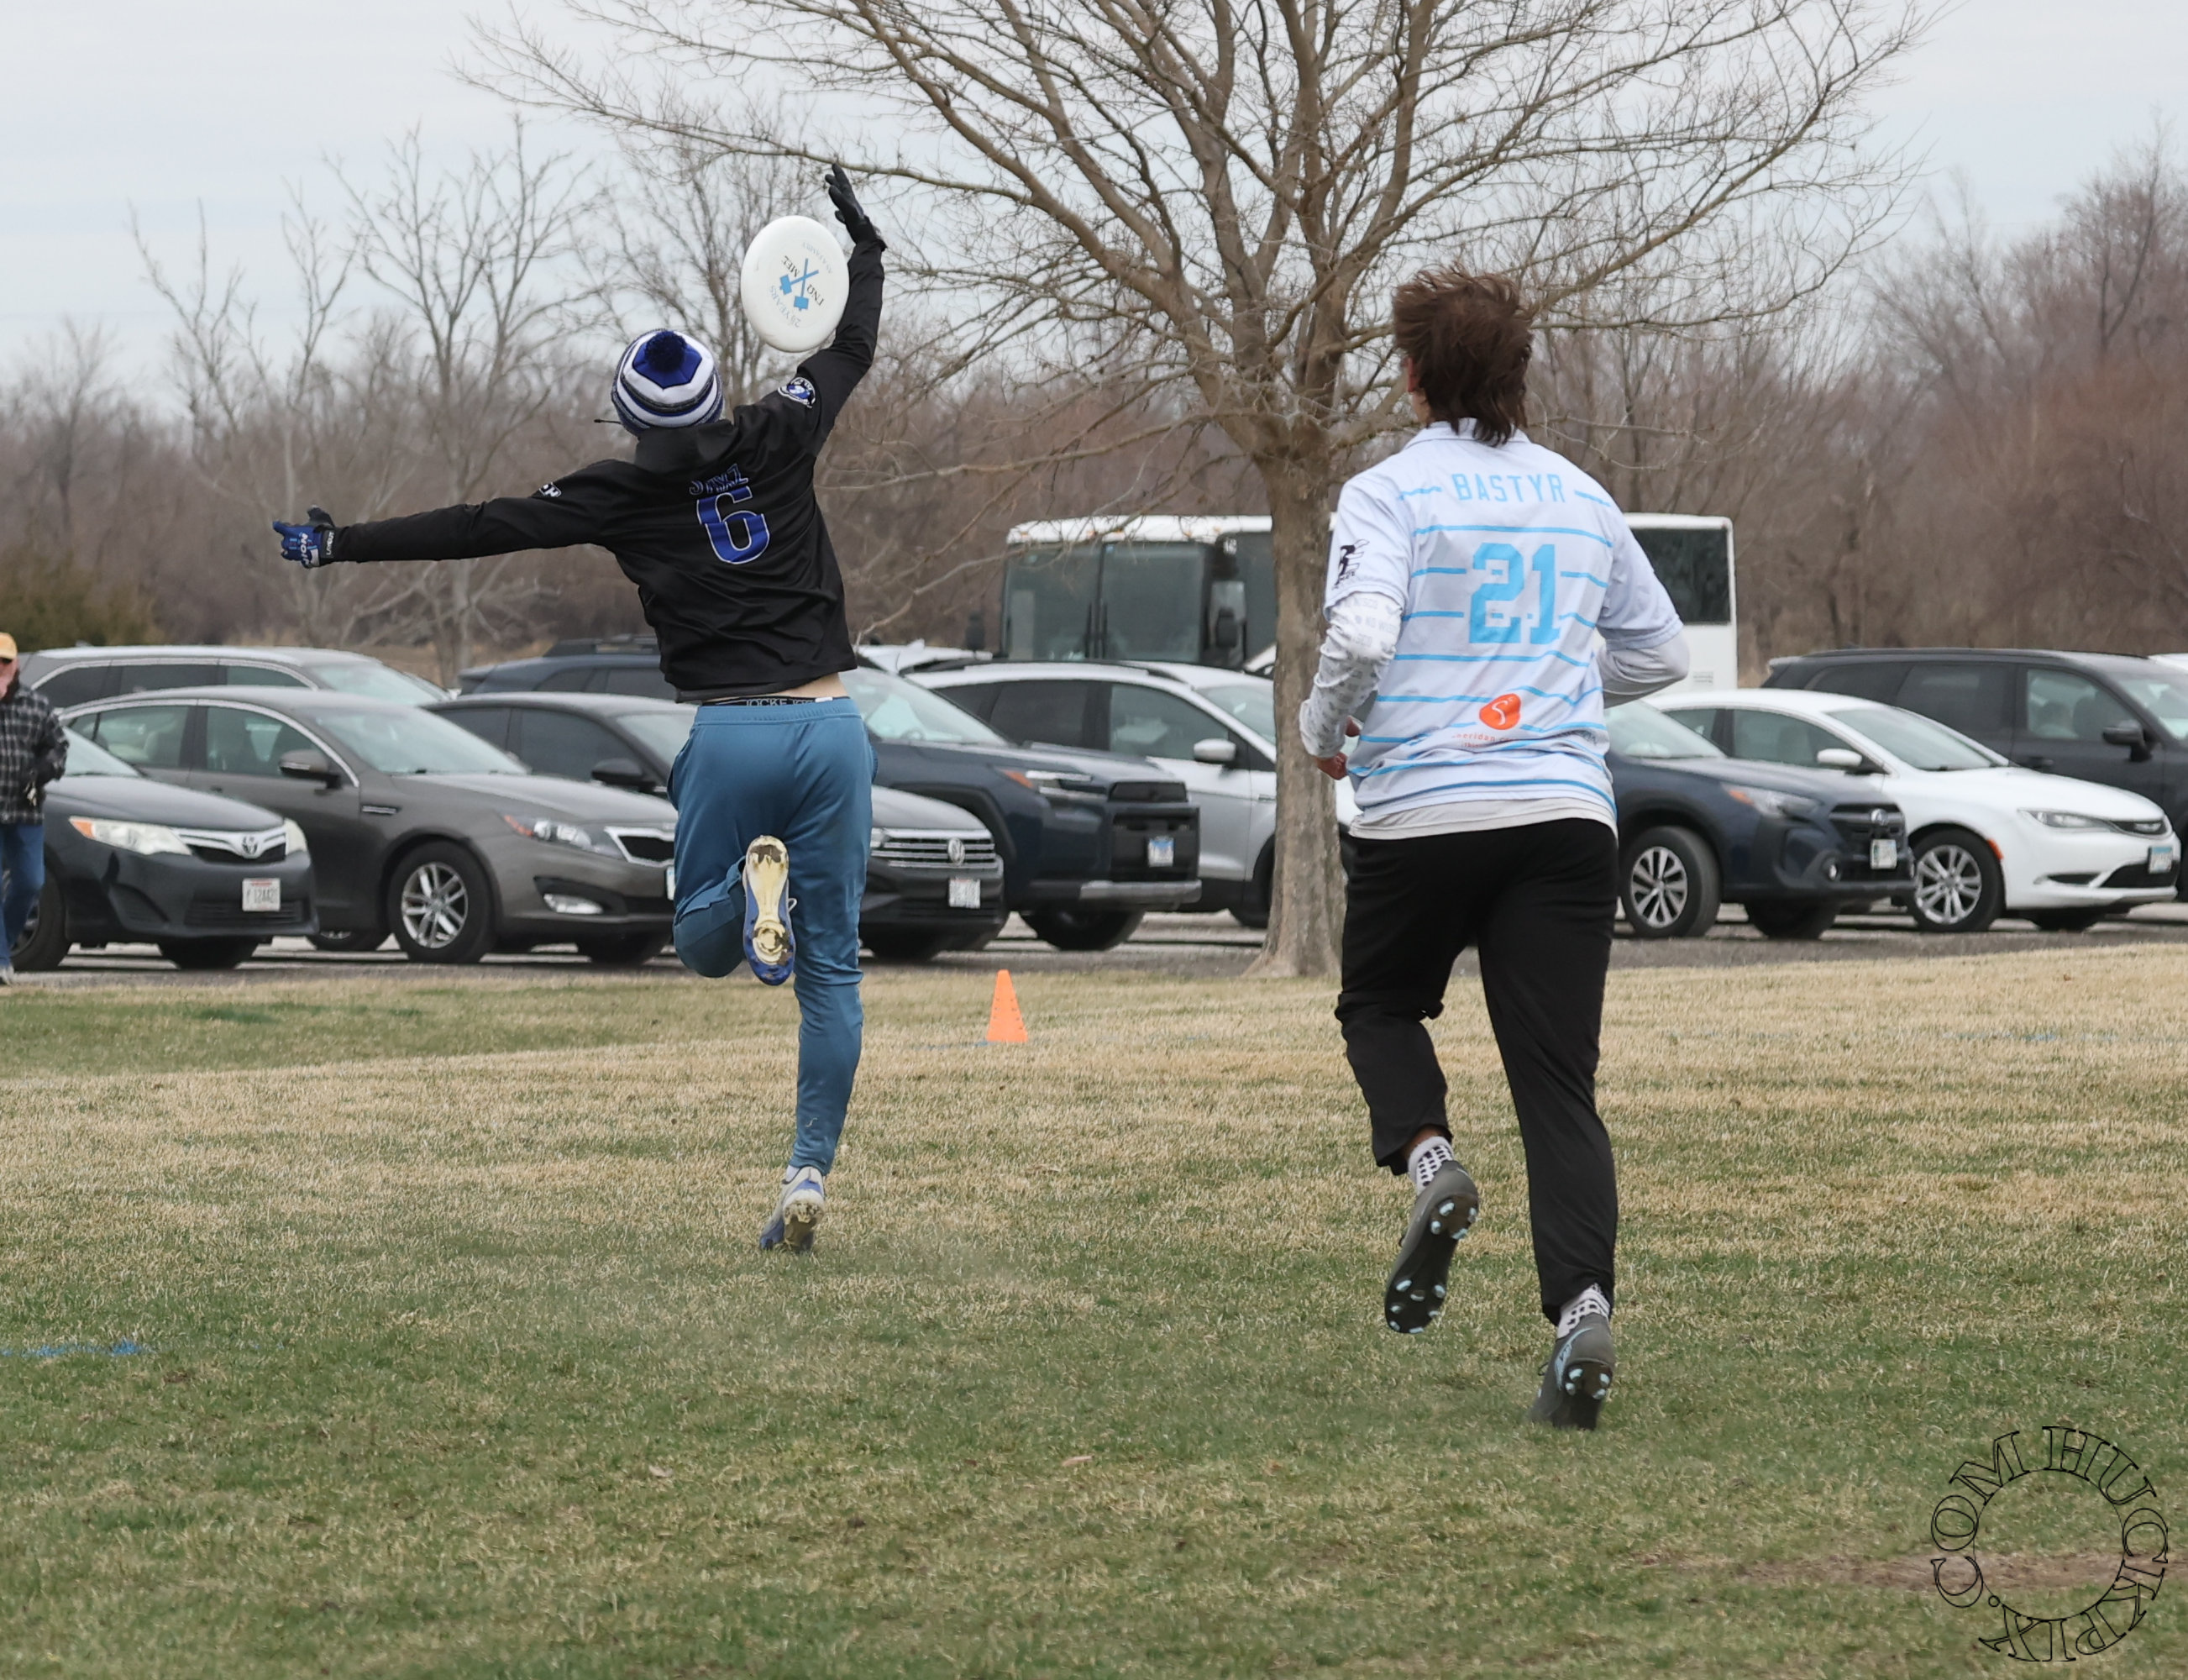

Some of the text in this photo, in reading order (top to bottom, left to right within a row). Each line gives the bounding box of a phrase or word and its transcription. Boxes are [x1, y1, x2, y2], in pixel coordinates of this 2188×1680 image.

[769, 286, 790, 319] YEARS
[1451, 473, 1566, 502] BASTYR
[696, 485, 770, 564] 6
[1468, 542, 1561, 645] 21
